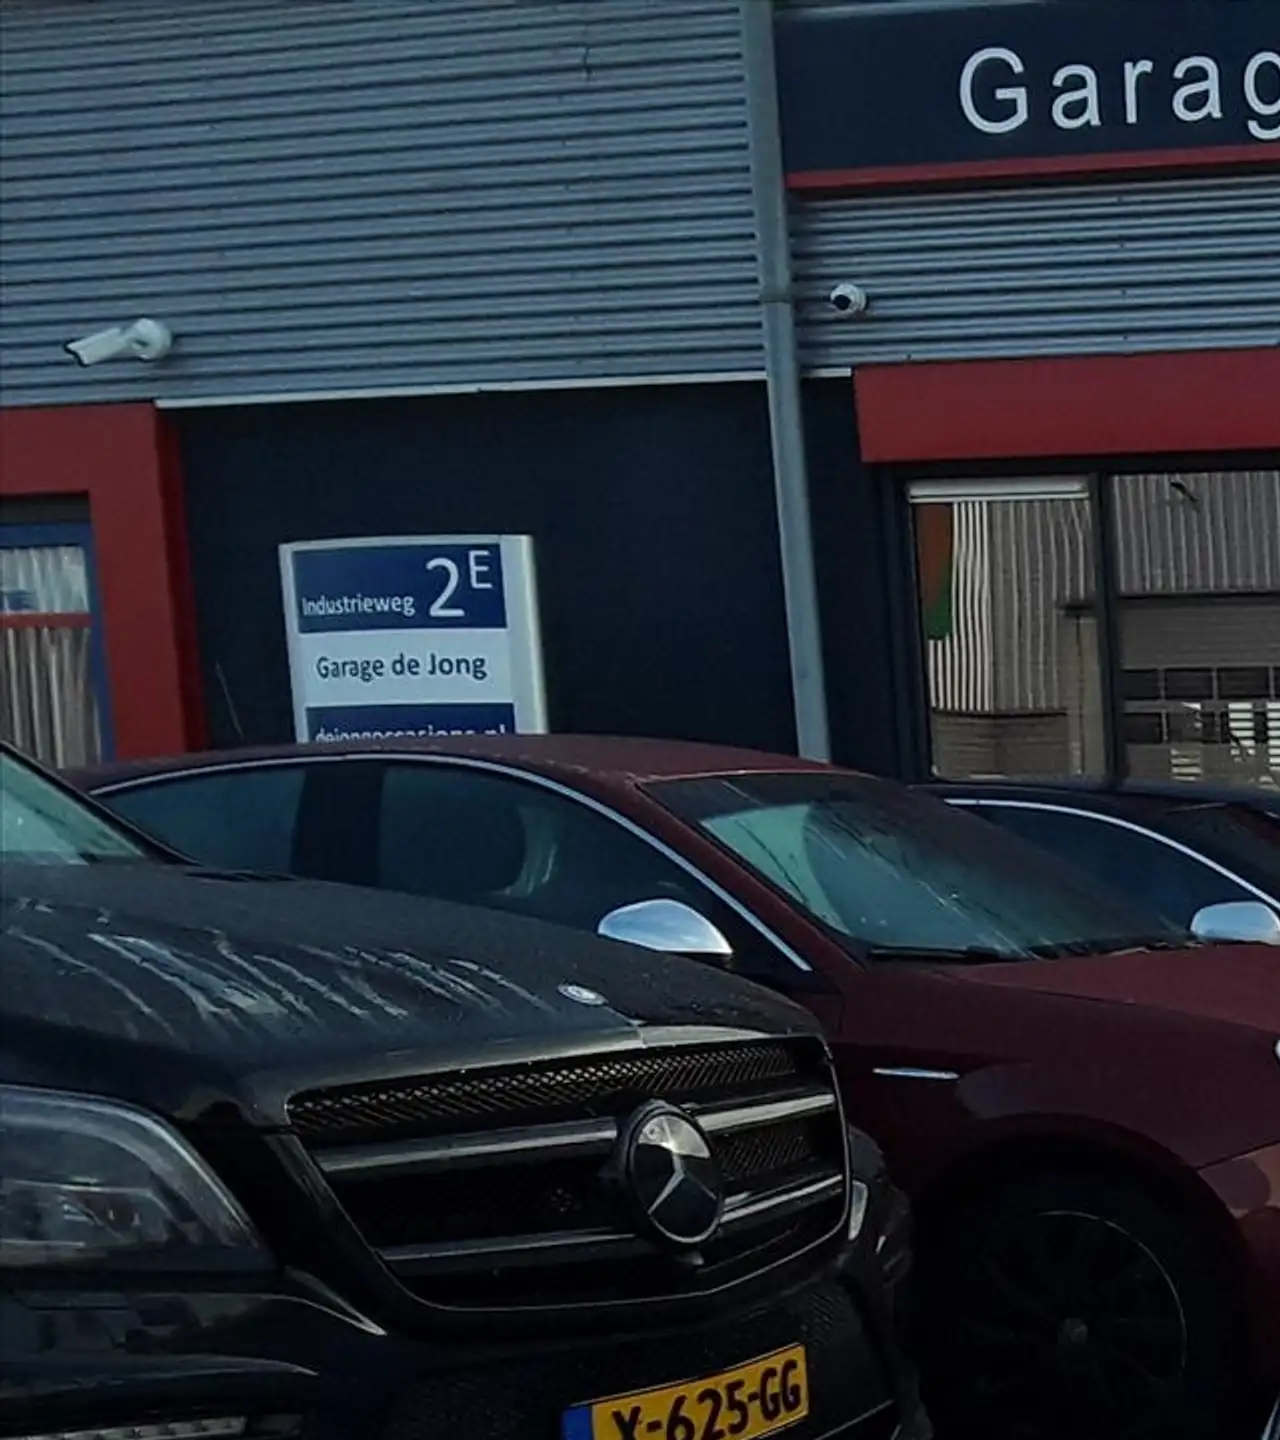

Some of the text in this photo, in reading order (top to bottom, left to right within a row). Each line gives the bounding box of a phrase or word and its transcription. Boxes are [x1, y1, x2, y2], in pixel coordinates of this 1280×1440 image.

[302, 594, 416, 617] Industrieweg
[316, 653, 488, 682] Garage de Jong
